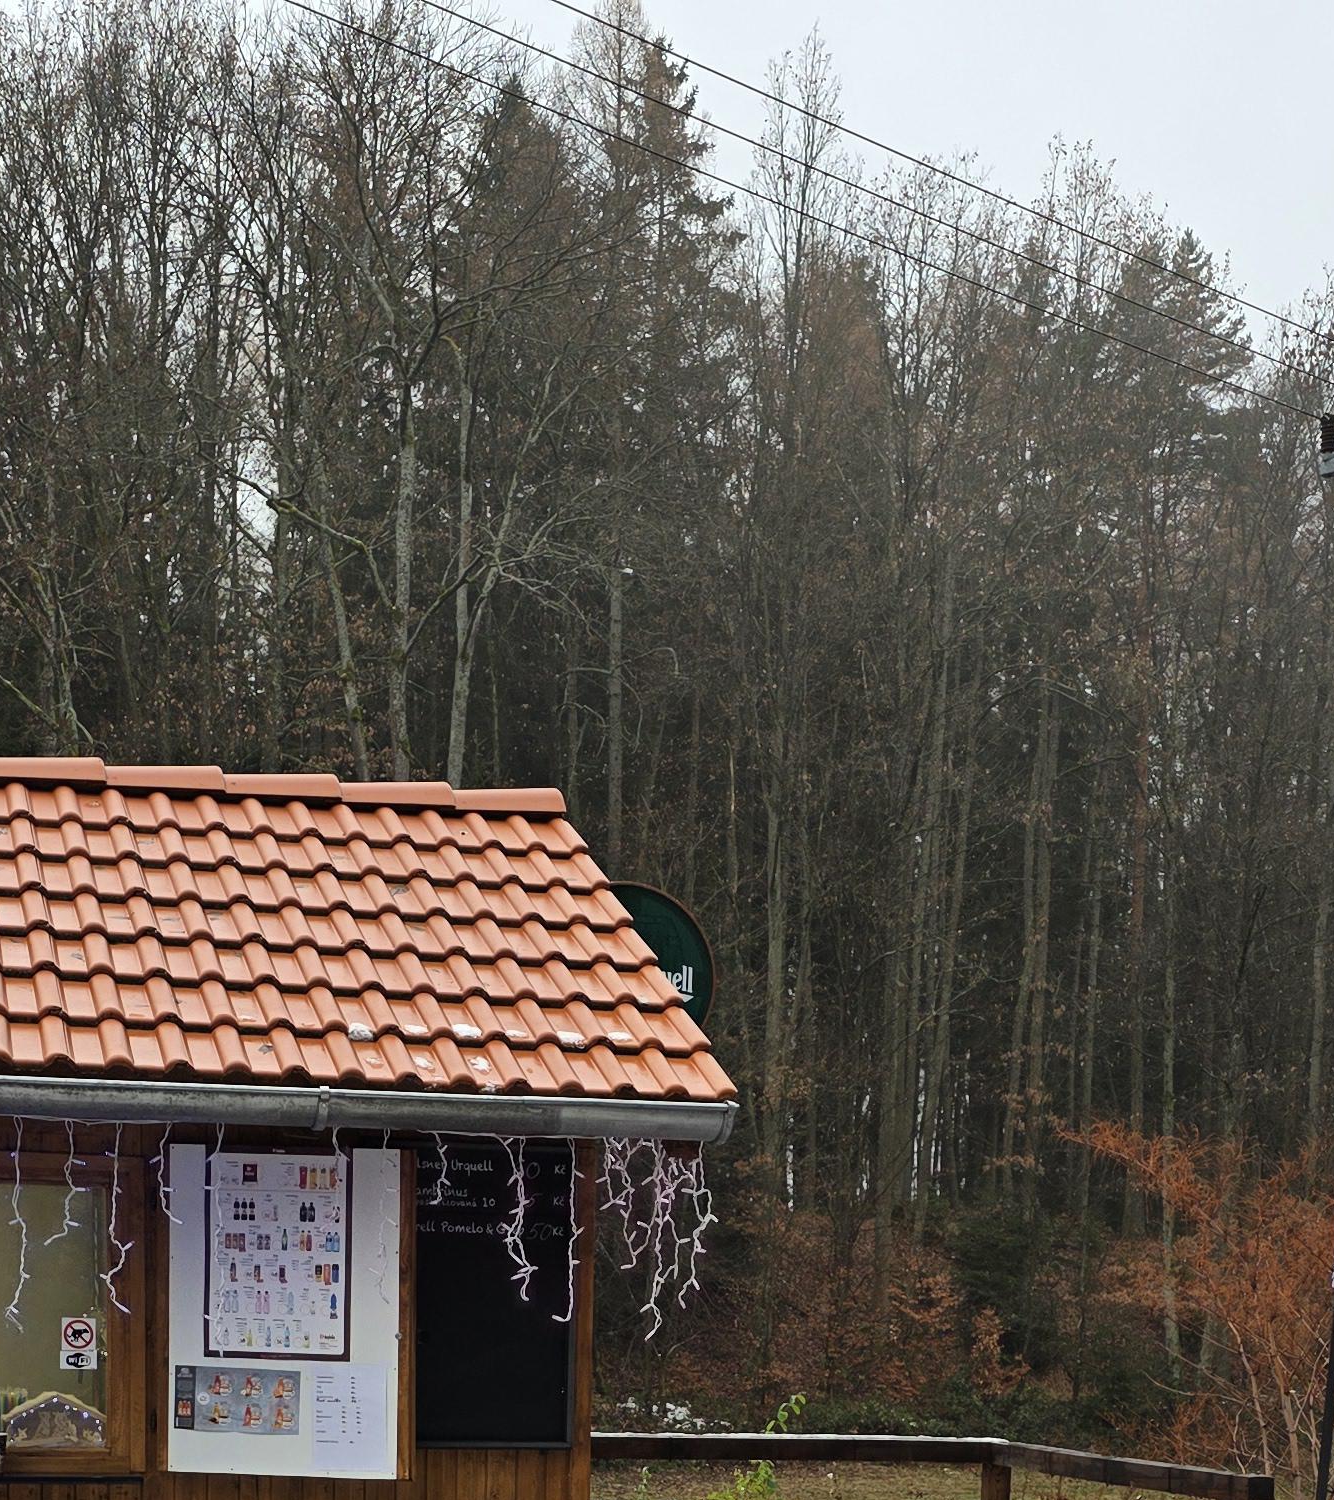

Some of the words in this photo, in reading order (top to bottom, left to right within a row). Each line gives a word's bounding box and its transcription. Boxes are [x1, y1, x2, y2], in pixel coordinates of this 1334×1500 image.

[451, 1159, 493, 1176] Urquell
[482, 1197, 496, 1208] 10
[440, 1220, 484, 1234] Pomelo
